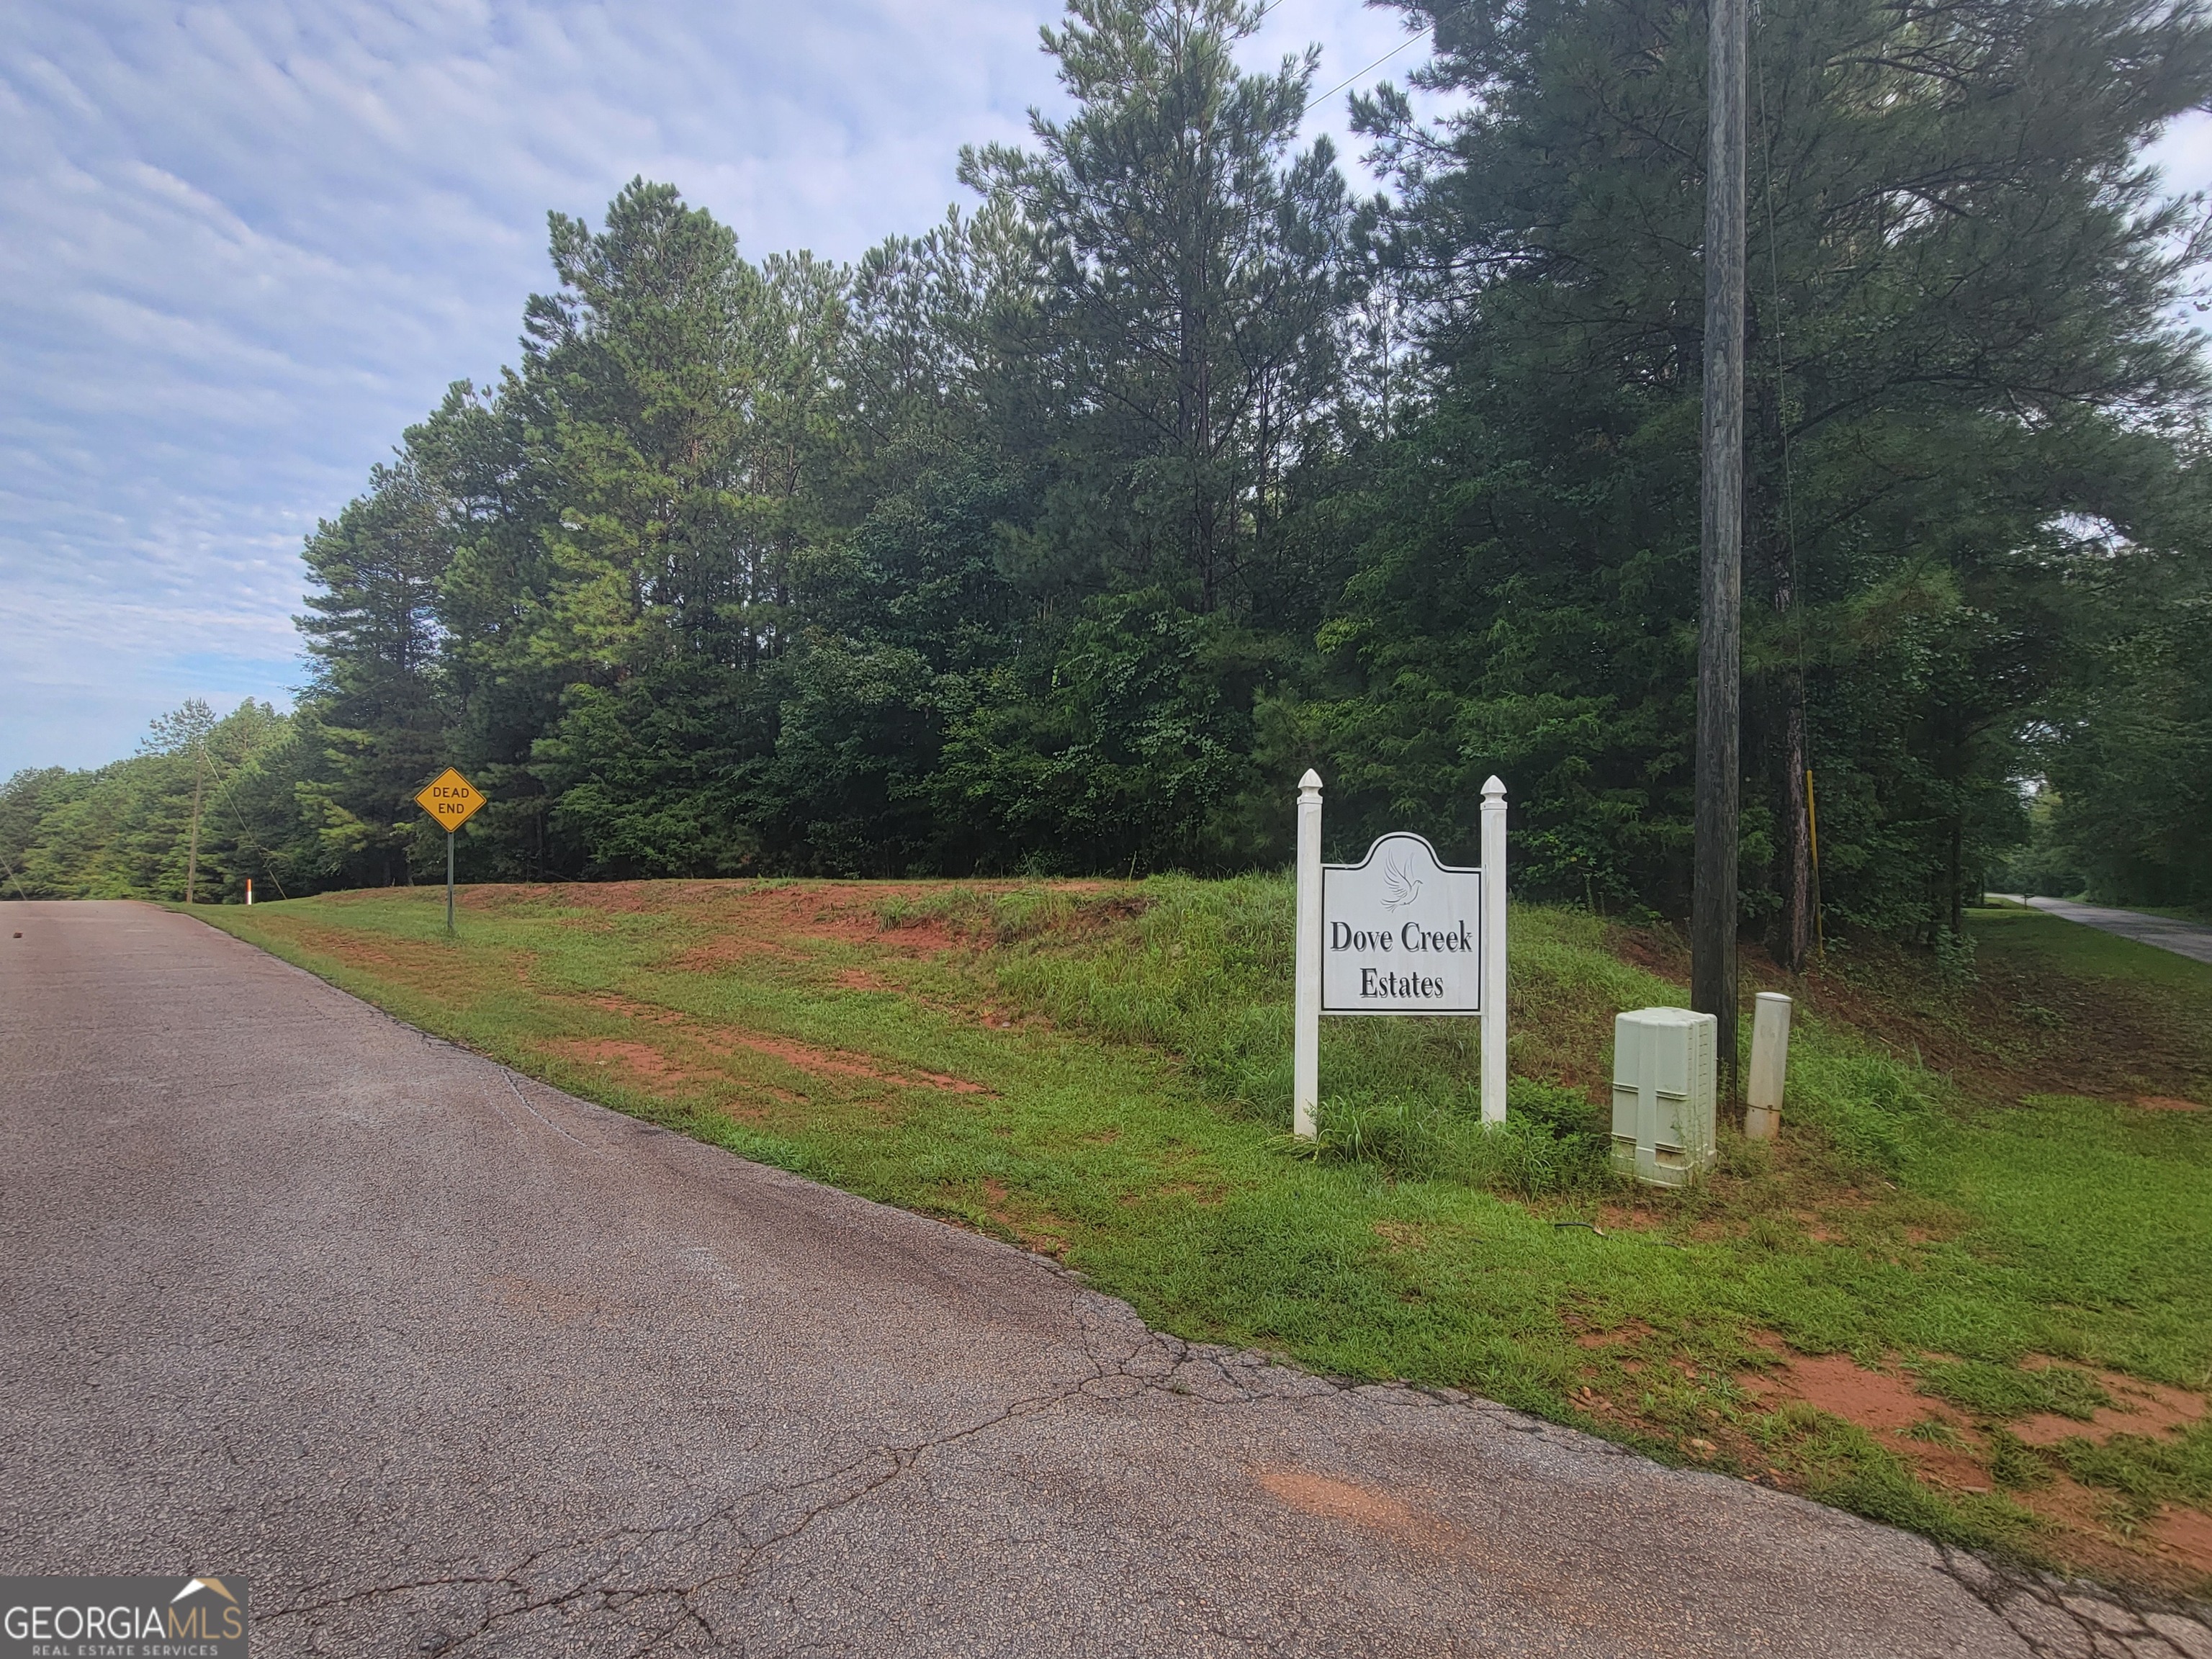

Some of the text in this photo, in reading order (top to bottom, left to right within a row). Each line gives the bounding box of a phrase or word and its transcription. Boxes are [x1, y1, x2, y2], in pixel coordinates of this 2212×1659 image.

[433, 787, 469, 798] DEAD
[439, 803, 464, 814] END
[1330, 920, 1473, 953] Dove Creek
[1359, 967, 1444, 998] Estates
